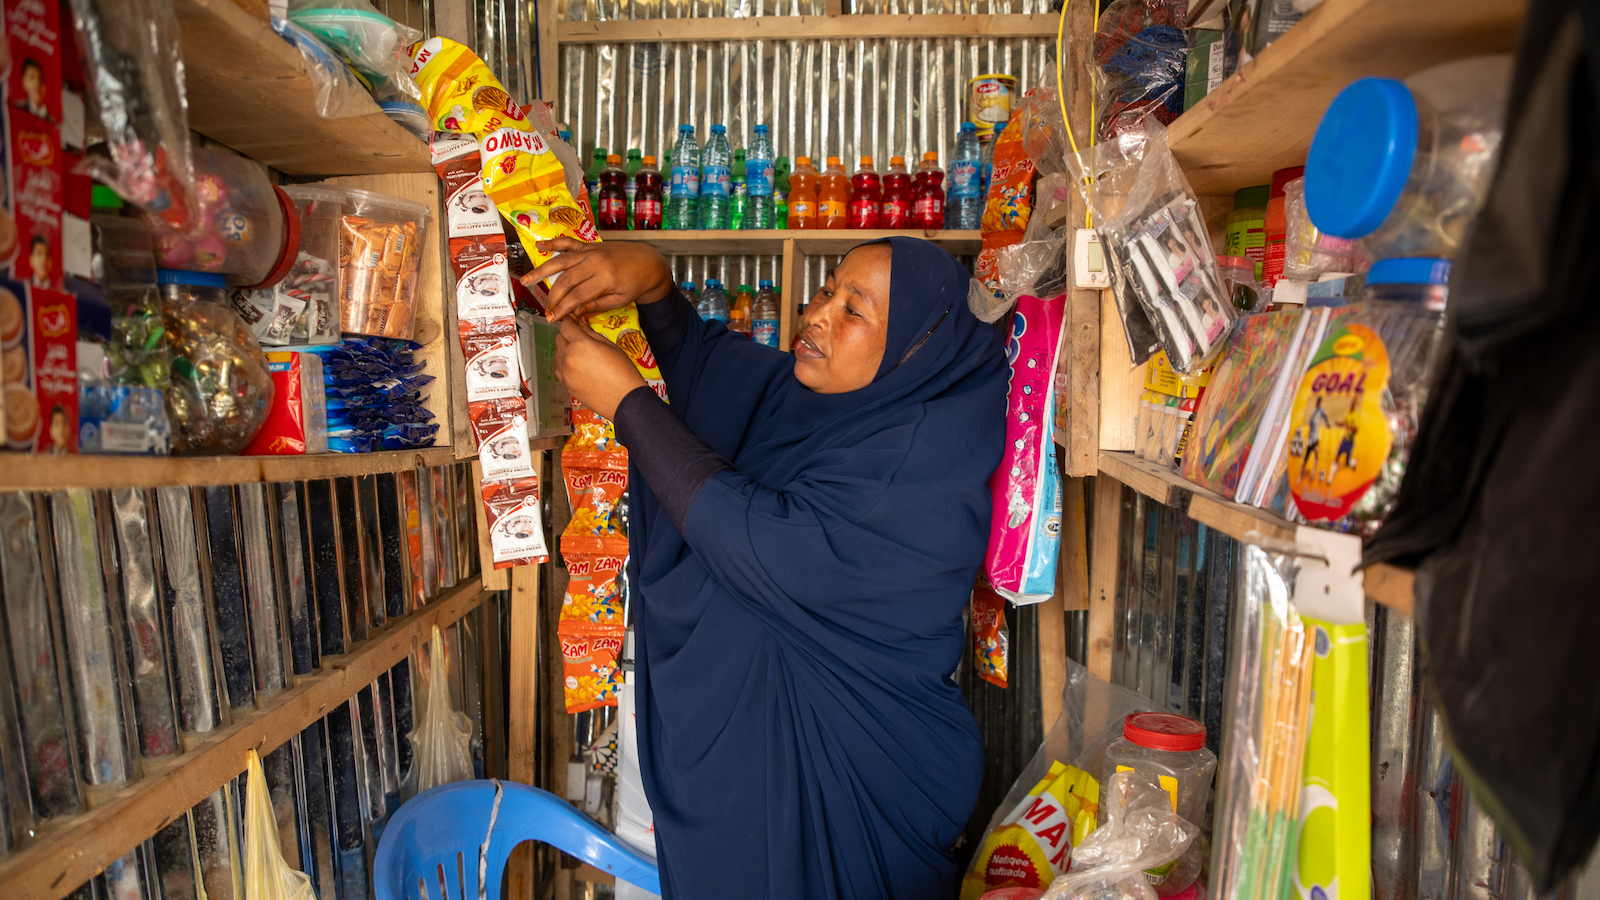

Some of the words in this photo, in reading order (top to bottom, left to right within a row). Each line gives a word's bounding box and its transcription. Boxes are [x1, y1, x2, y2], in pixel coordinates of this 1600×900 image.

[485, 131, 543, 152] MARWO
[270, 309, 289, 336] Coffee
[317, 302, 328, 331] Coffee
[1311, 371, 1367, 394] GOAL
[569, 472, 593, 489] ZAM
[597, 470, 627, 489] ZAM
[593, 556, 622, 574] ZAM
[562, 640, 588, 658] ZAM
[592, 637, 620, 654] ZAM
